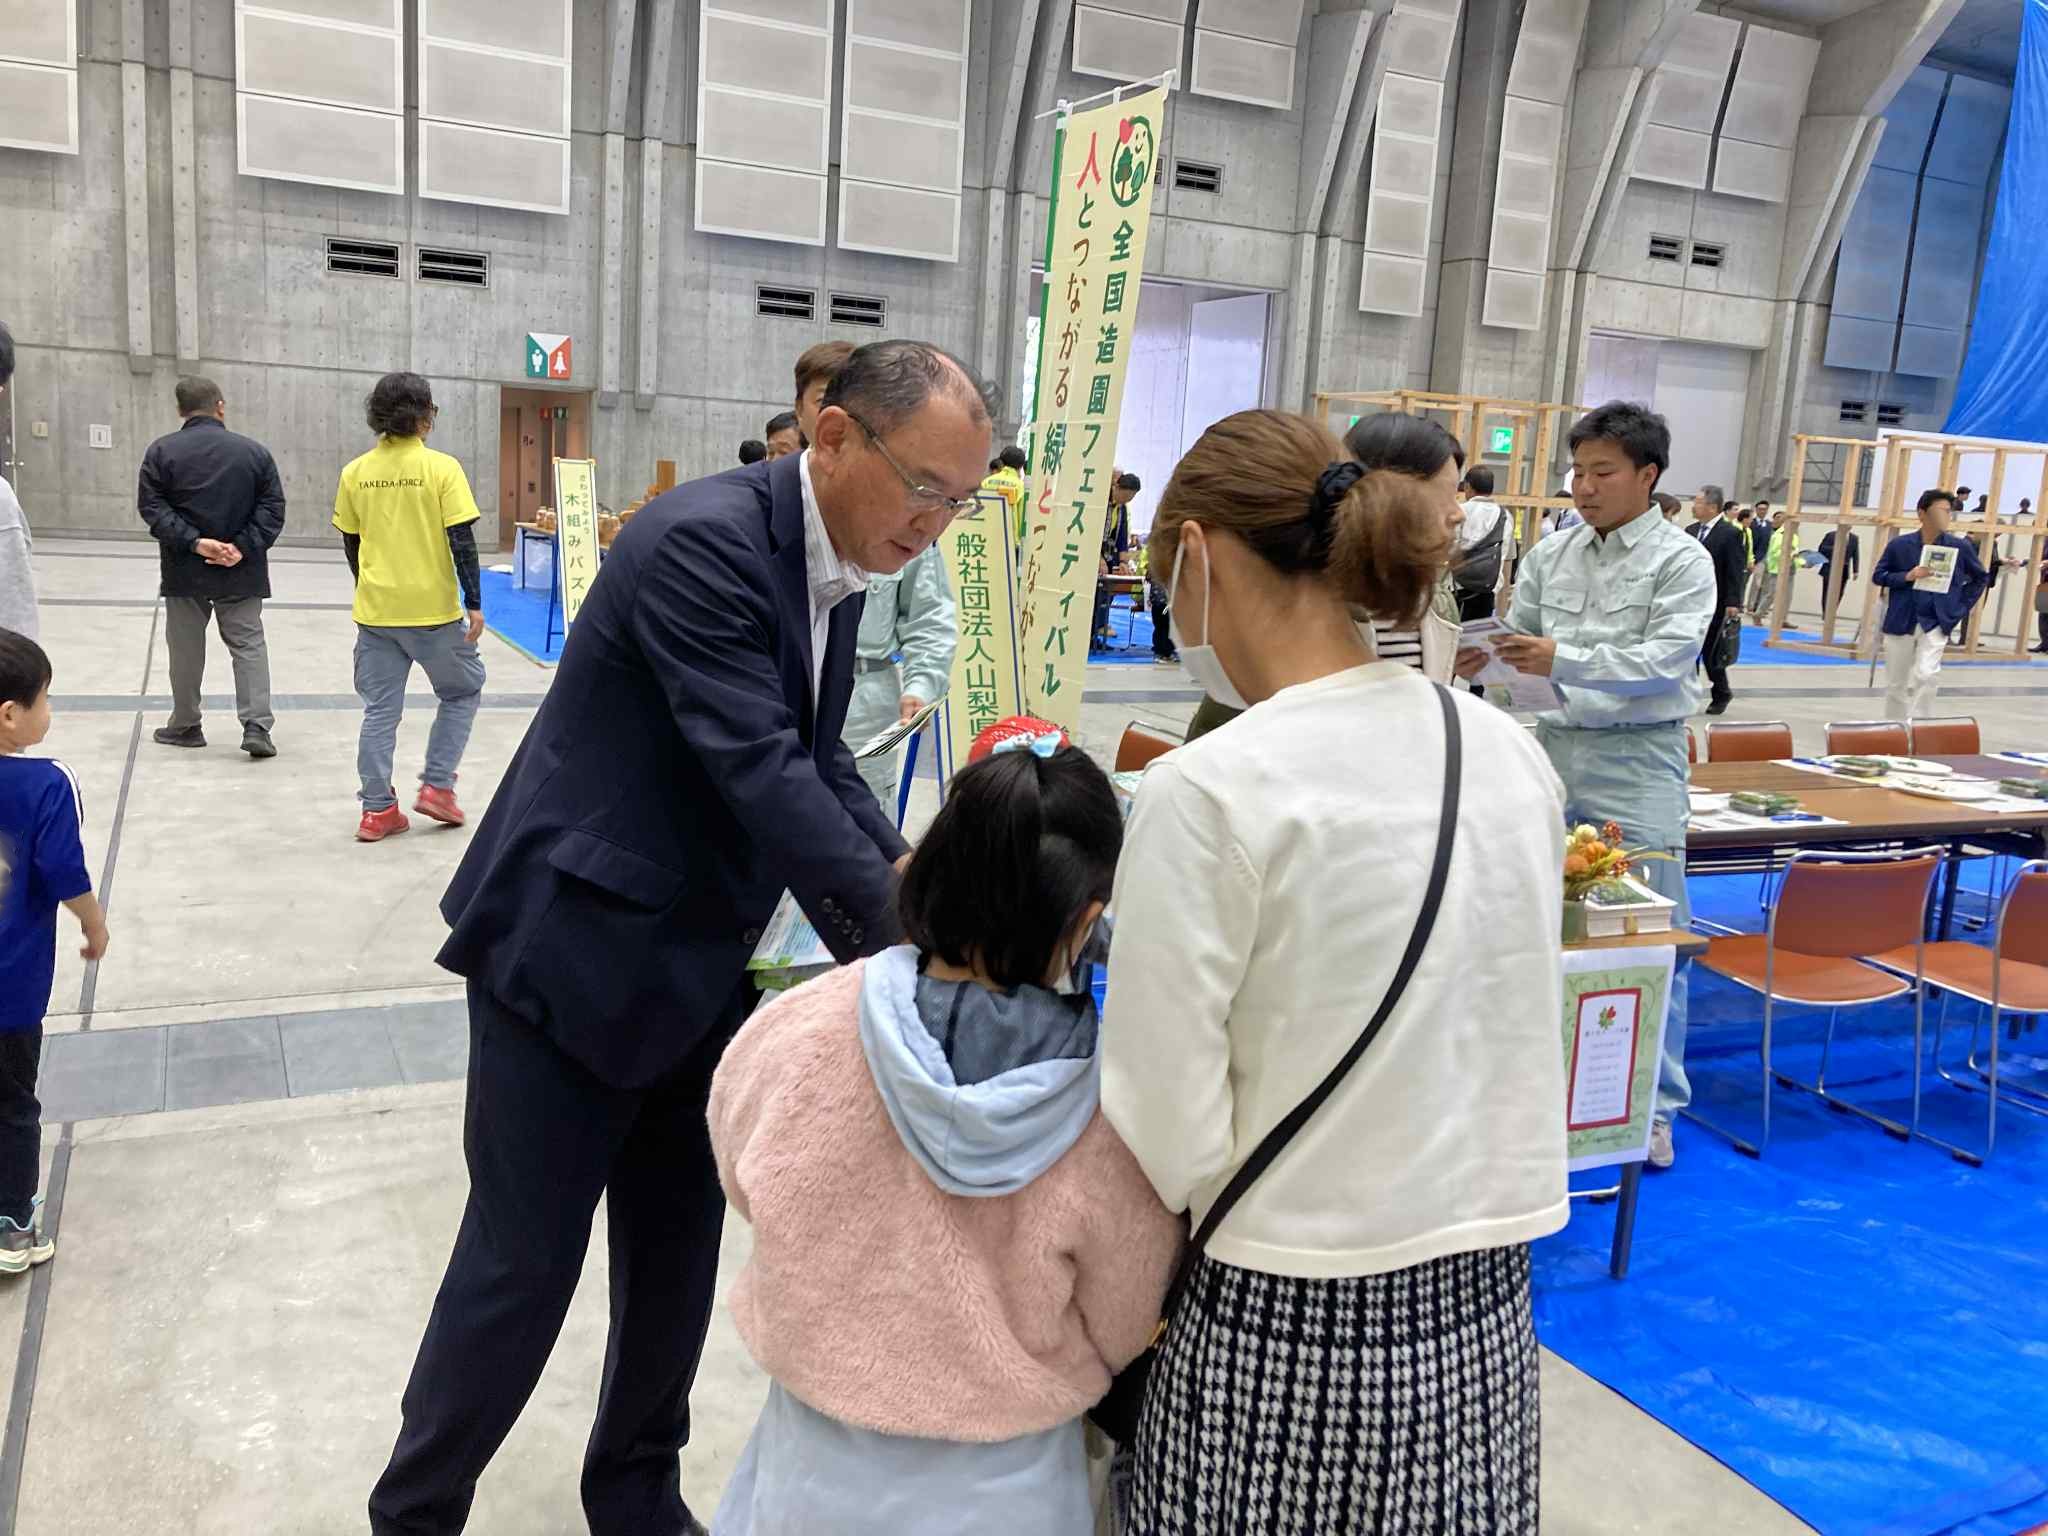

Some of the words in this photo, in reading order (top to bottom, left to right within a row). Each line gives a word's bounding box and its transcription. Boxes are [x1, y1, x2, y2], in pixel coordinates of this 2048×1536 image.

[1055, 132, 1101, 408] 人とつながる
[1040, 220, 1134, 697] 全国造園フェスティバル
